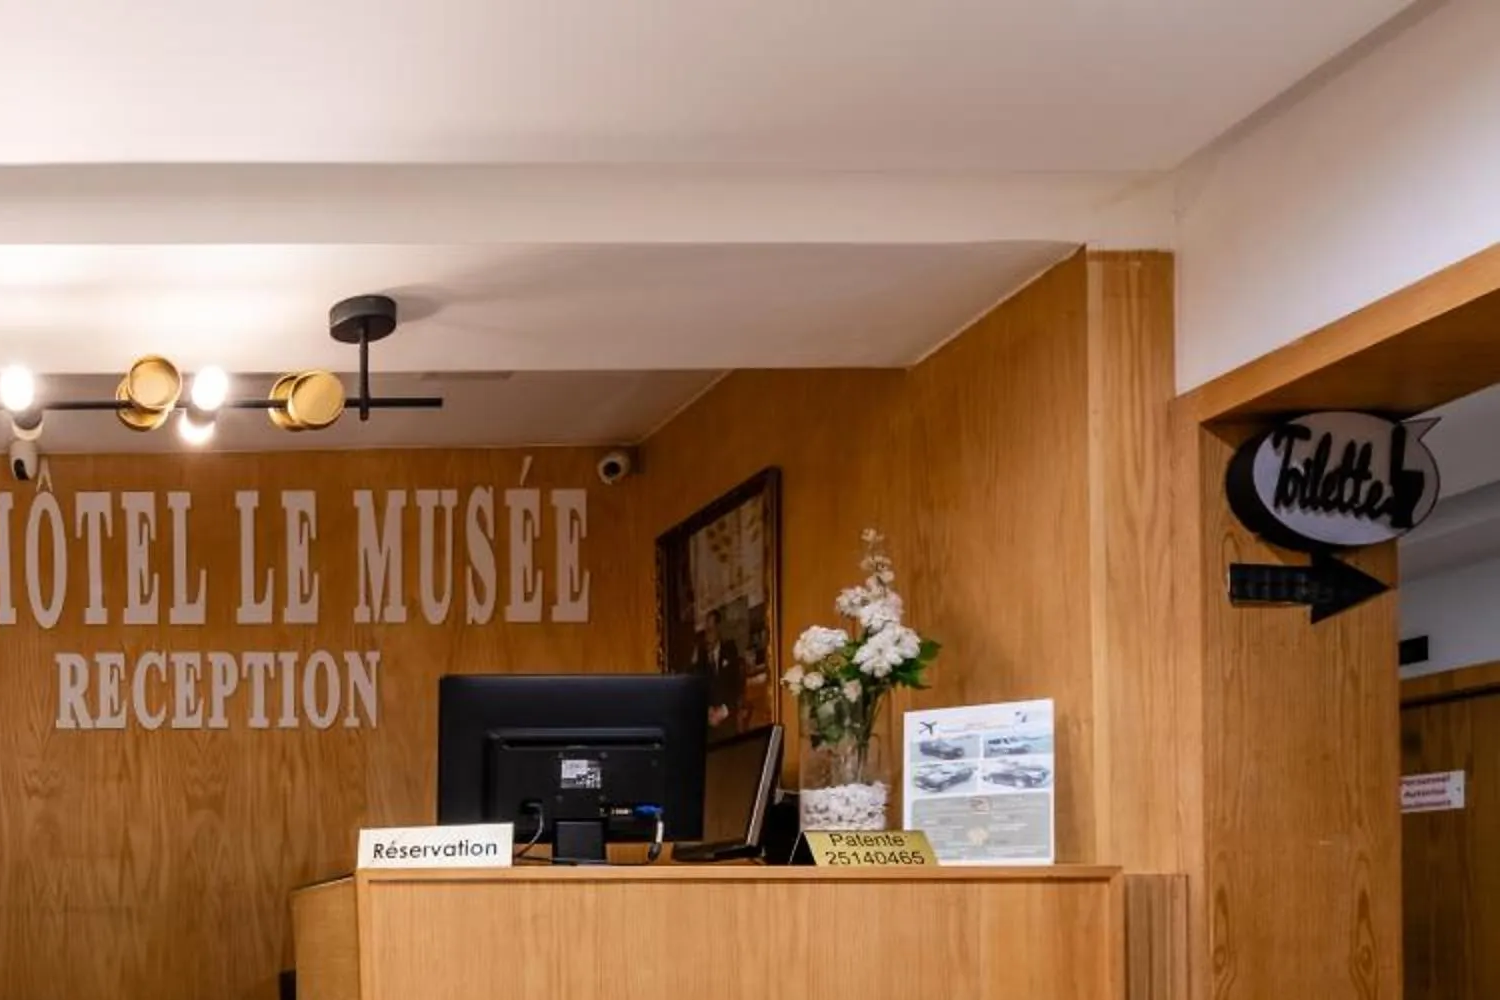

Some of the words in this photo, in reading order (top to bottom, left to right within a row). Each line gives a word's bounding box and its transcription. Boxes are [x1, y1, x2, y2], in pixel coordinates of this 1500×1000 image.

[235, 490, 319, 625] LE
[353, 456, 590, 626] MUSÉE
[55, 650, 382, 731] RECEPTION
[828, 832, 906, 847] Patente
[373, 840, 498, 859] Réservation
[825, 850, 925, 866] 25140465
